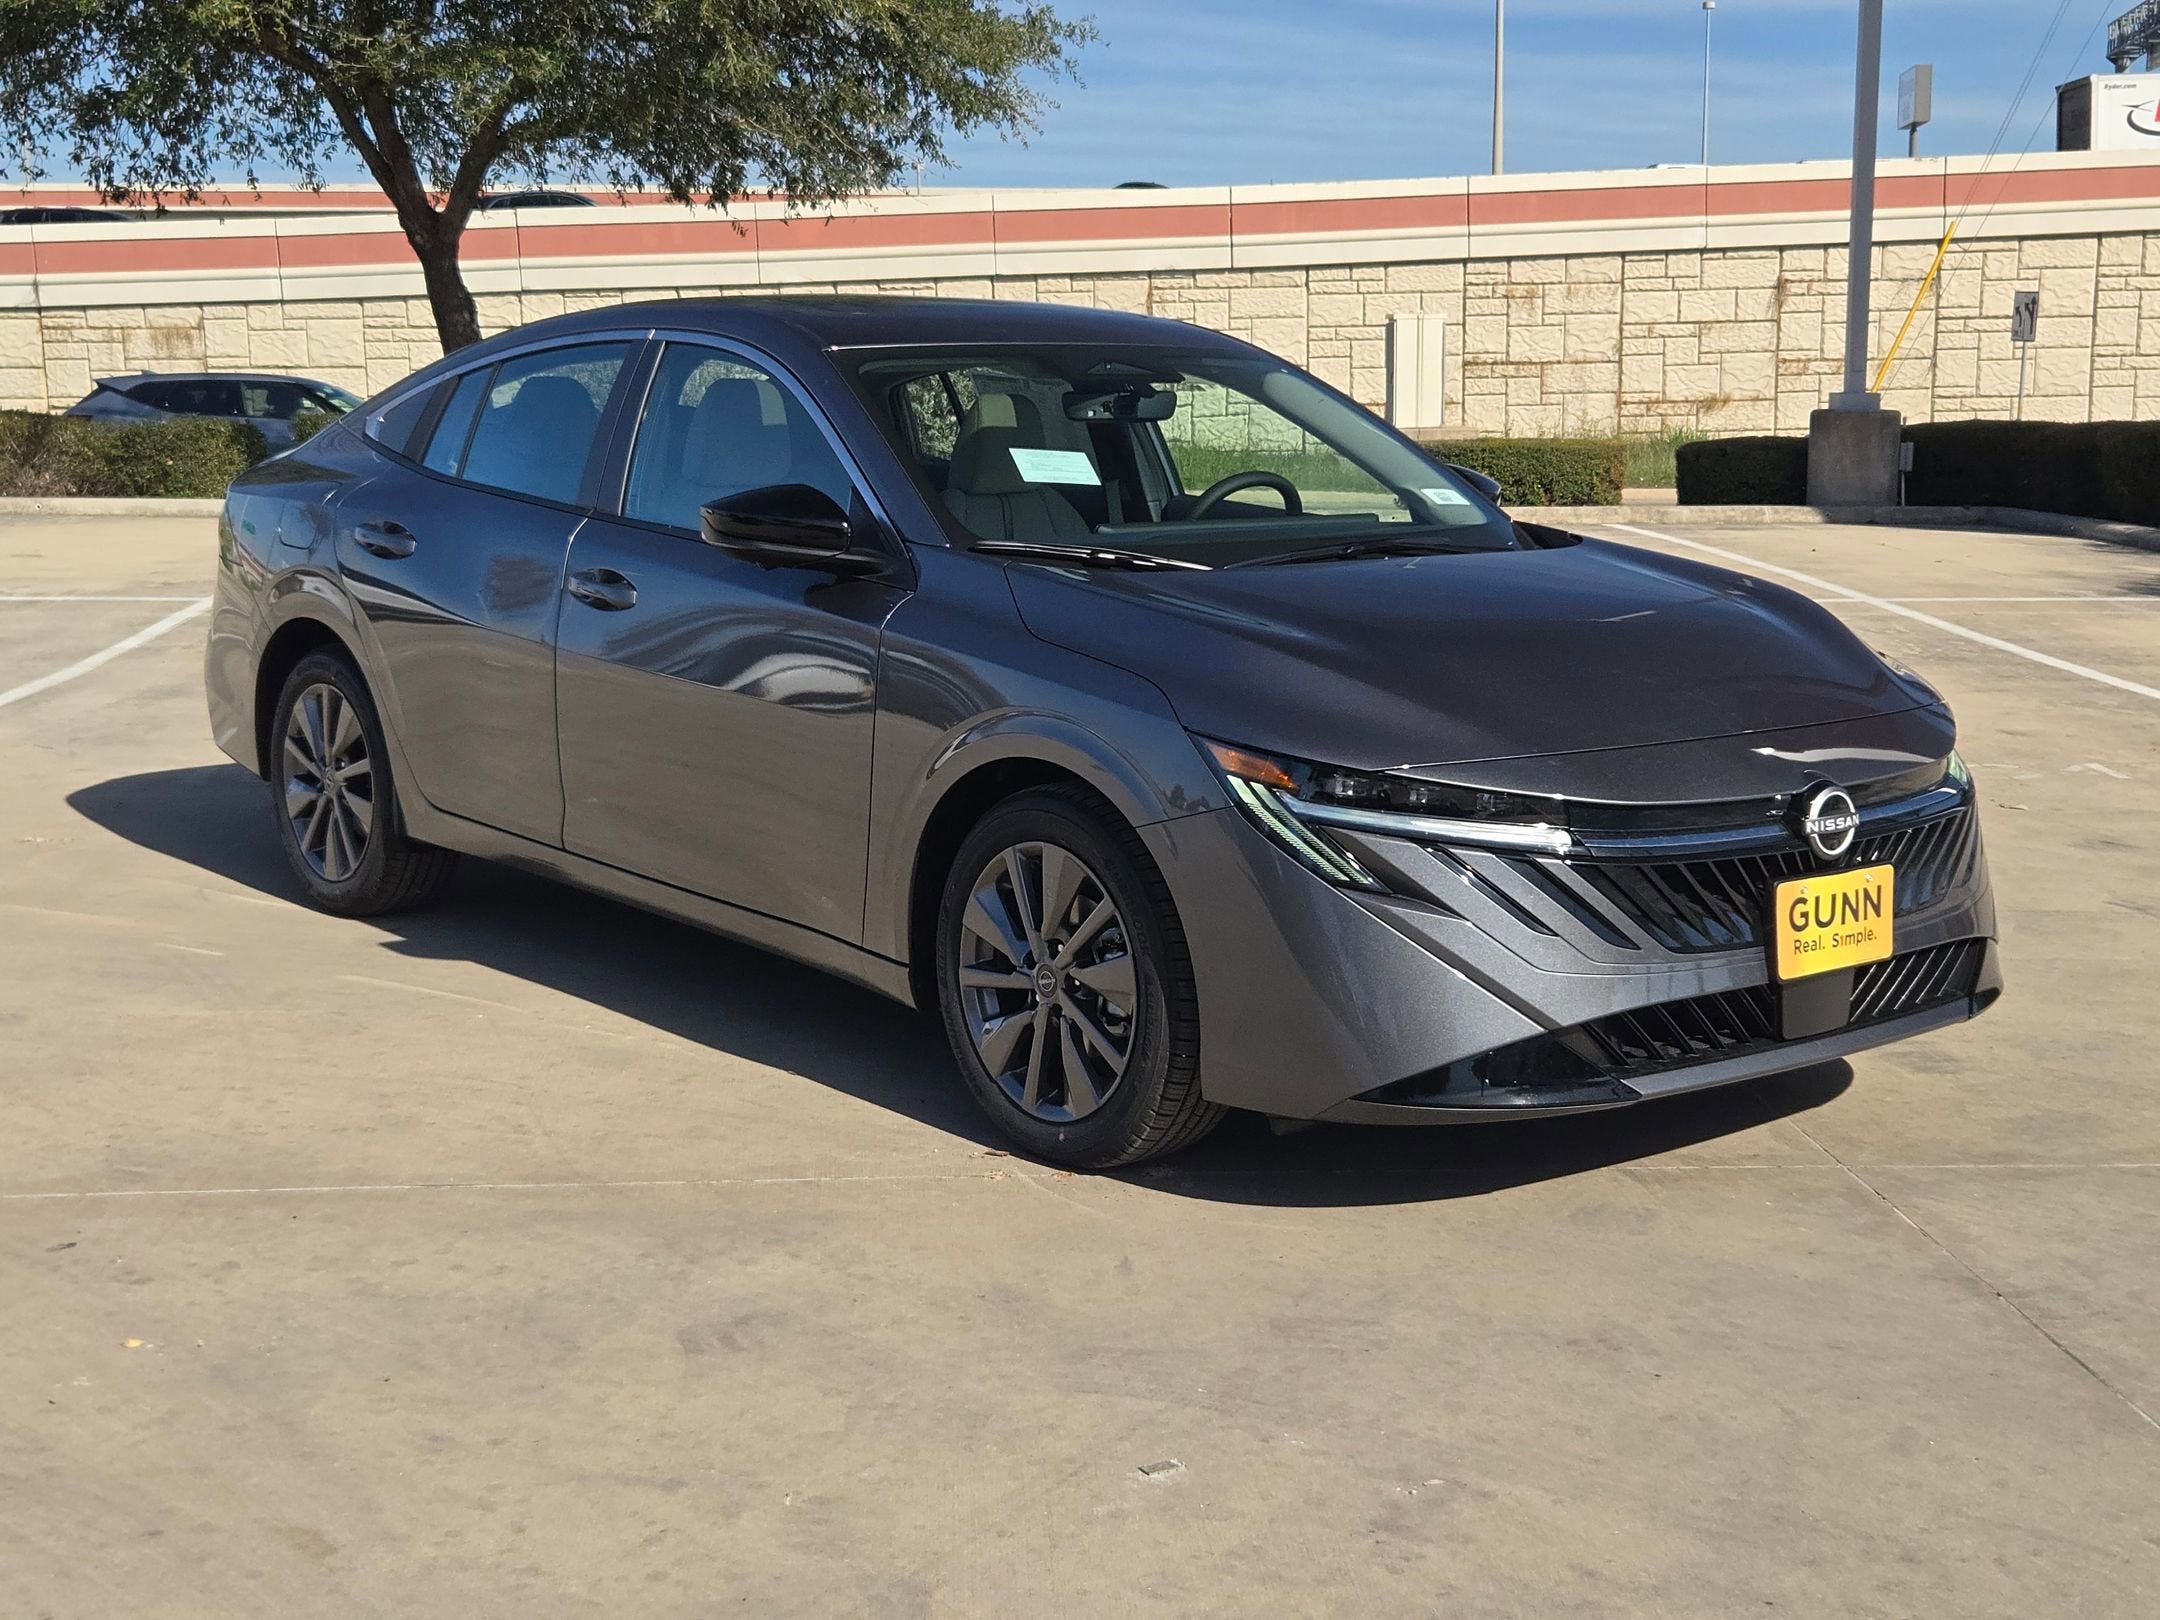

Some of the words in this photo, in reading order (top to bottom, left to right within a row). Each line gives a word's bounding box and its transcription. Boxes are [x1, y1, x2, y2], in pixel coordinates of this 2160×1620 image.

[1806, 814, 1859, 833] NISSAN
[1789, 885, 1882, 932] GUNN
[1793, 934, 1826, 955] Real.
